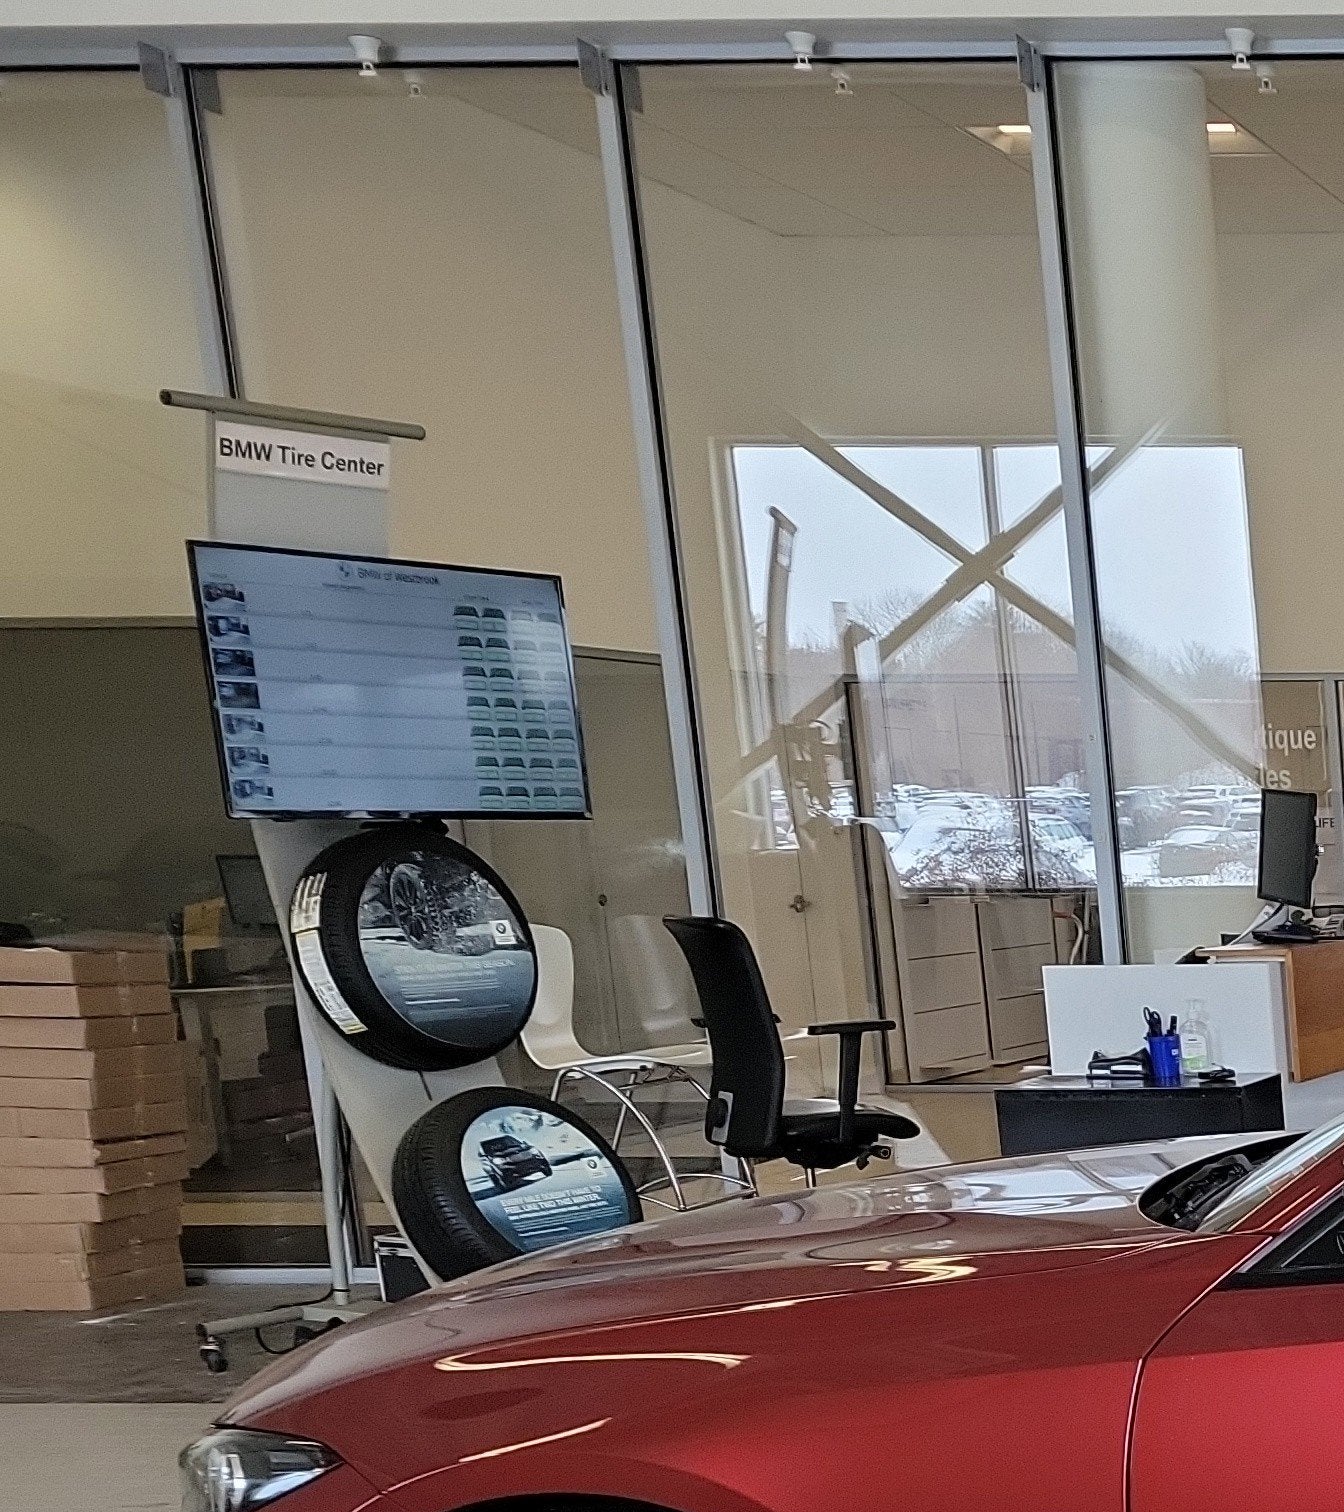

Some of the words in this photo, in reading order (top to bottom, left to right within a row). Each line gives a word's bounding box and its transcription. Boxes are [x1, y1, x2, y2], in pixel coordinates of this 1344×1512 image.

[219, 436, 273, 462] BMW
[276, 444, 316, 468] Tire
[320, 450, 385, 476] Center
